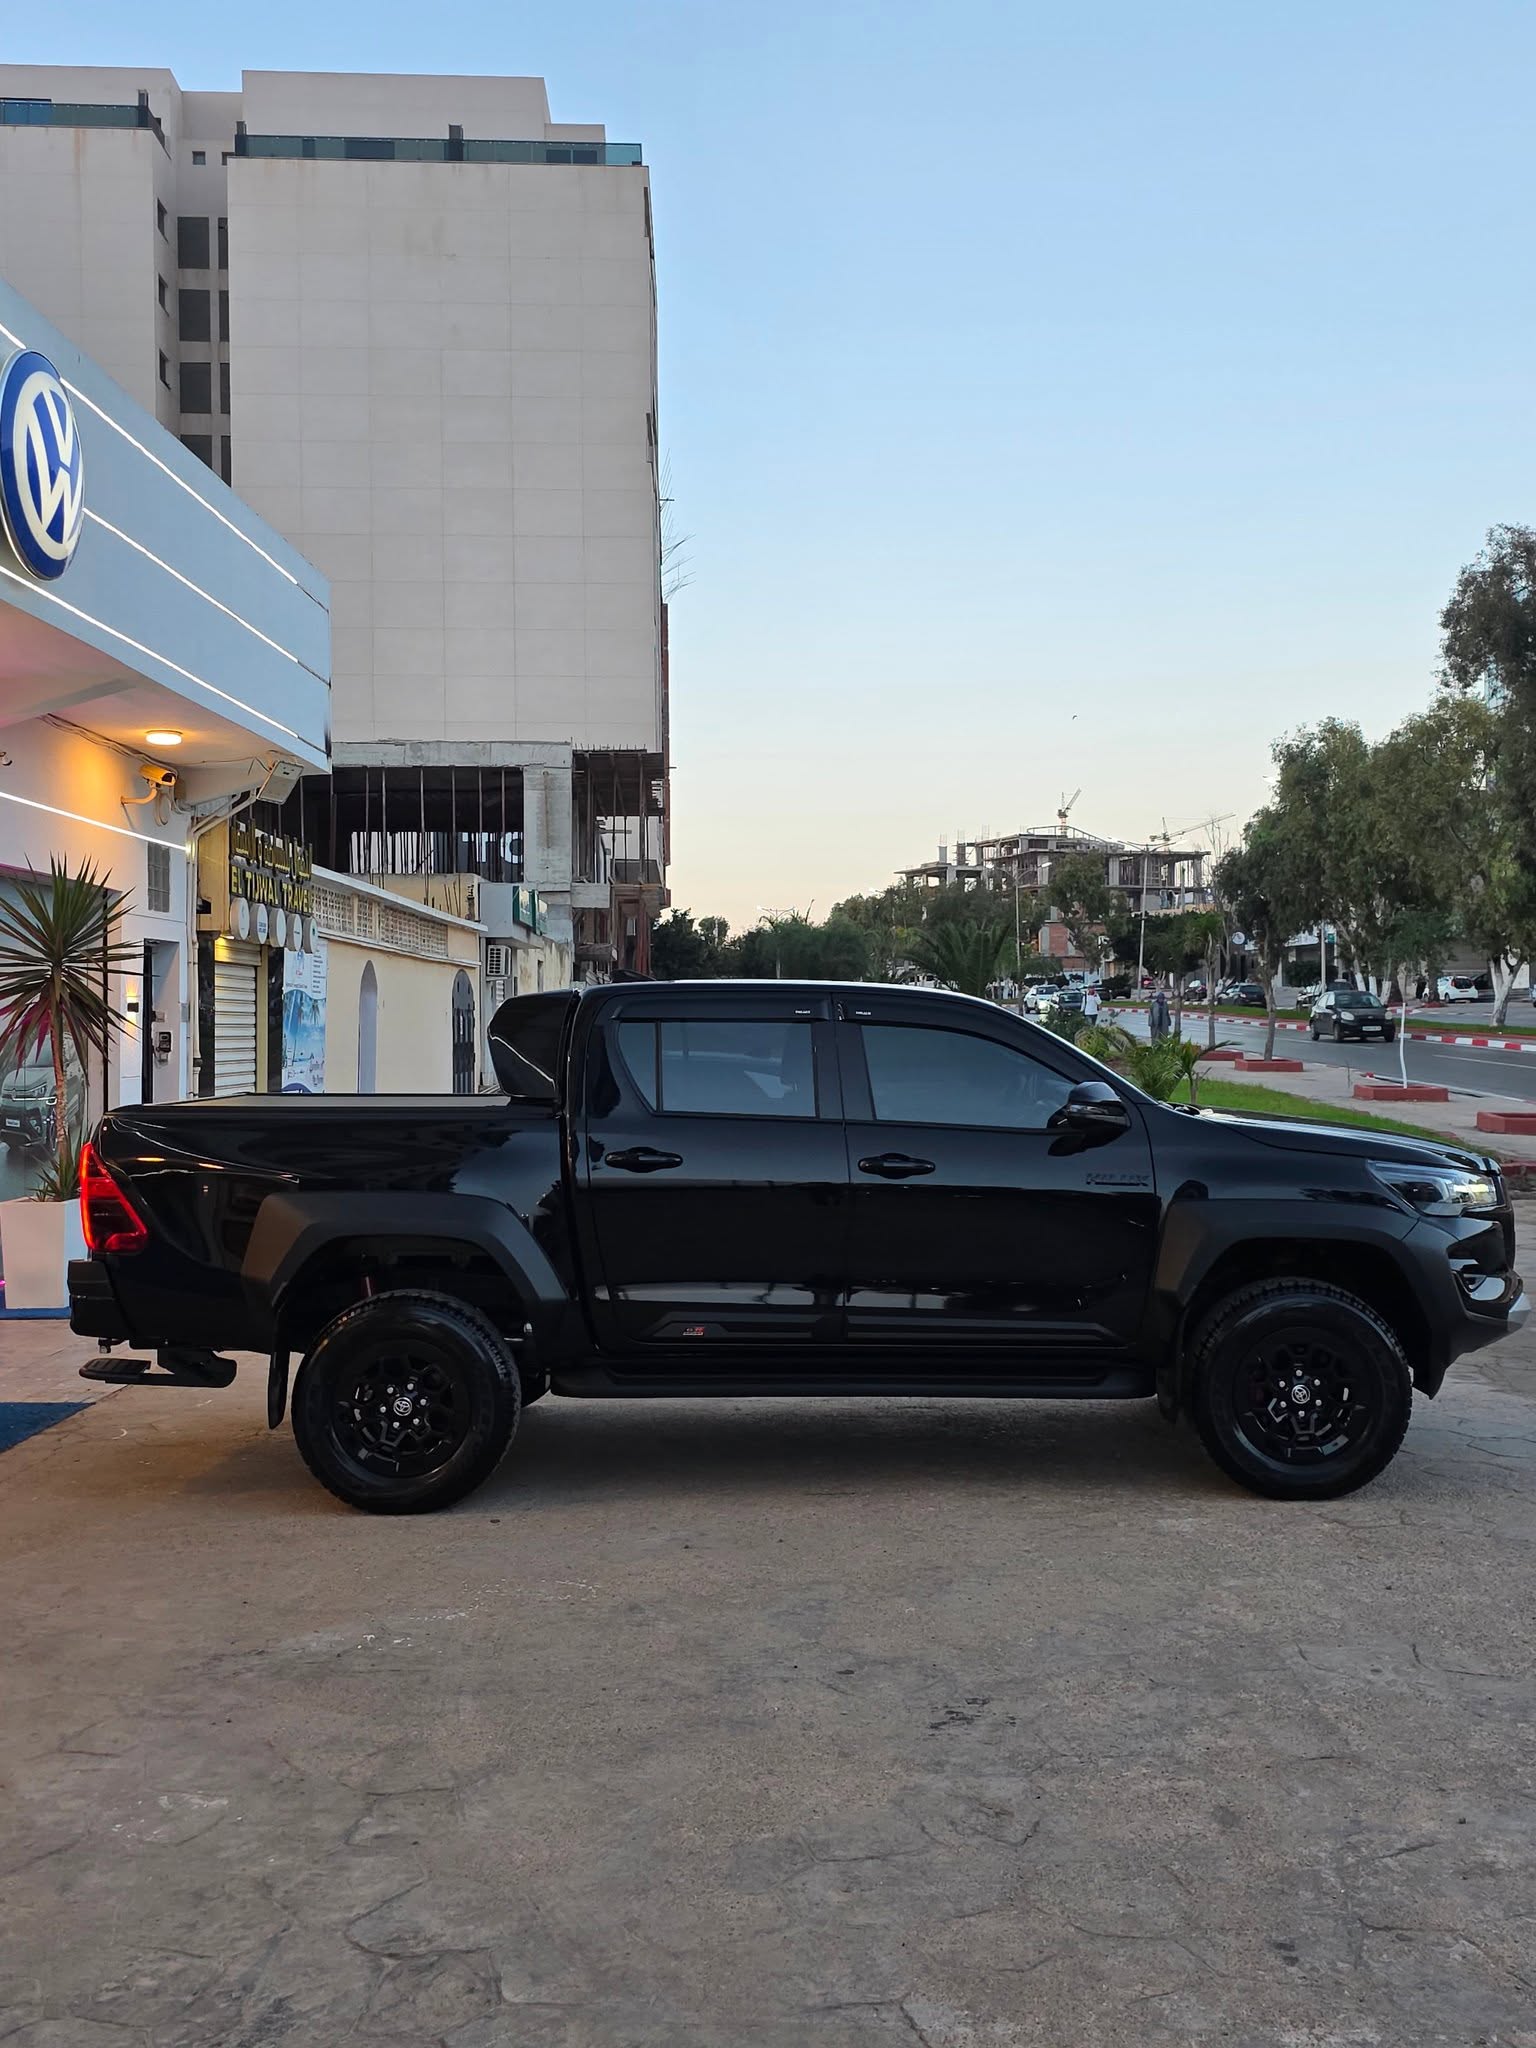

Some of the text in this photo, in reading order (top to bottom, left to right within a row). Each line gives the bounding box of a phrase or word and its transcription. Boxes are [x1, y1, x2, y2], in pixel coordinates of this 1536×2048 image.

[16, 374, 83, 558] VW
[231, 865, 243, 895] EL
[282, 882, 312, 914] TRAVEL
